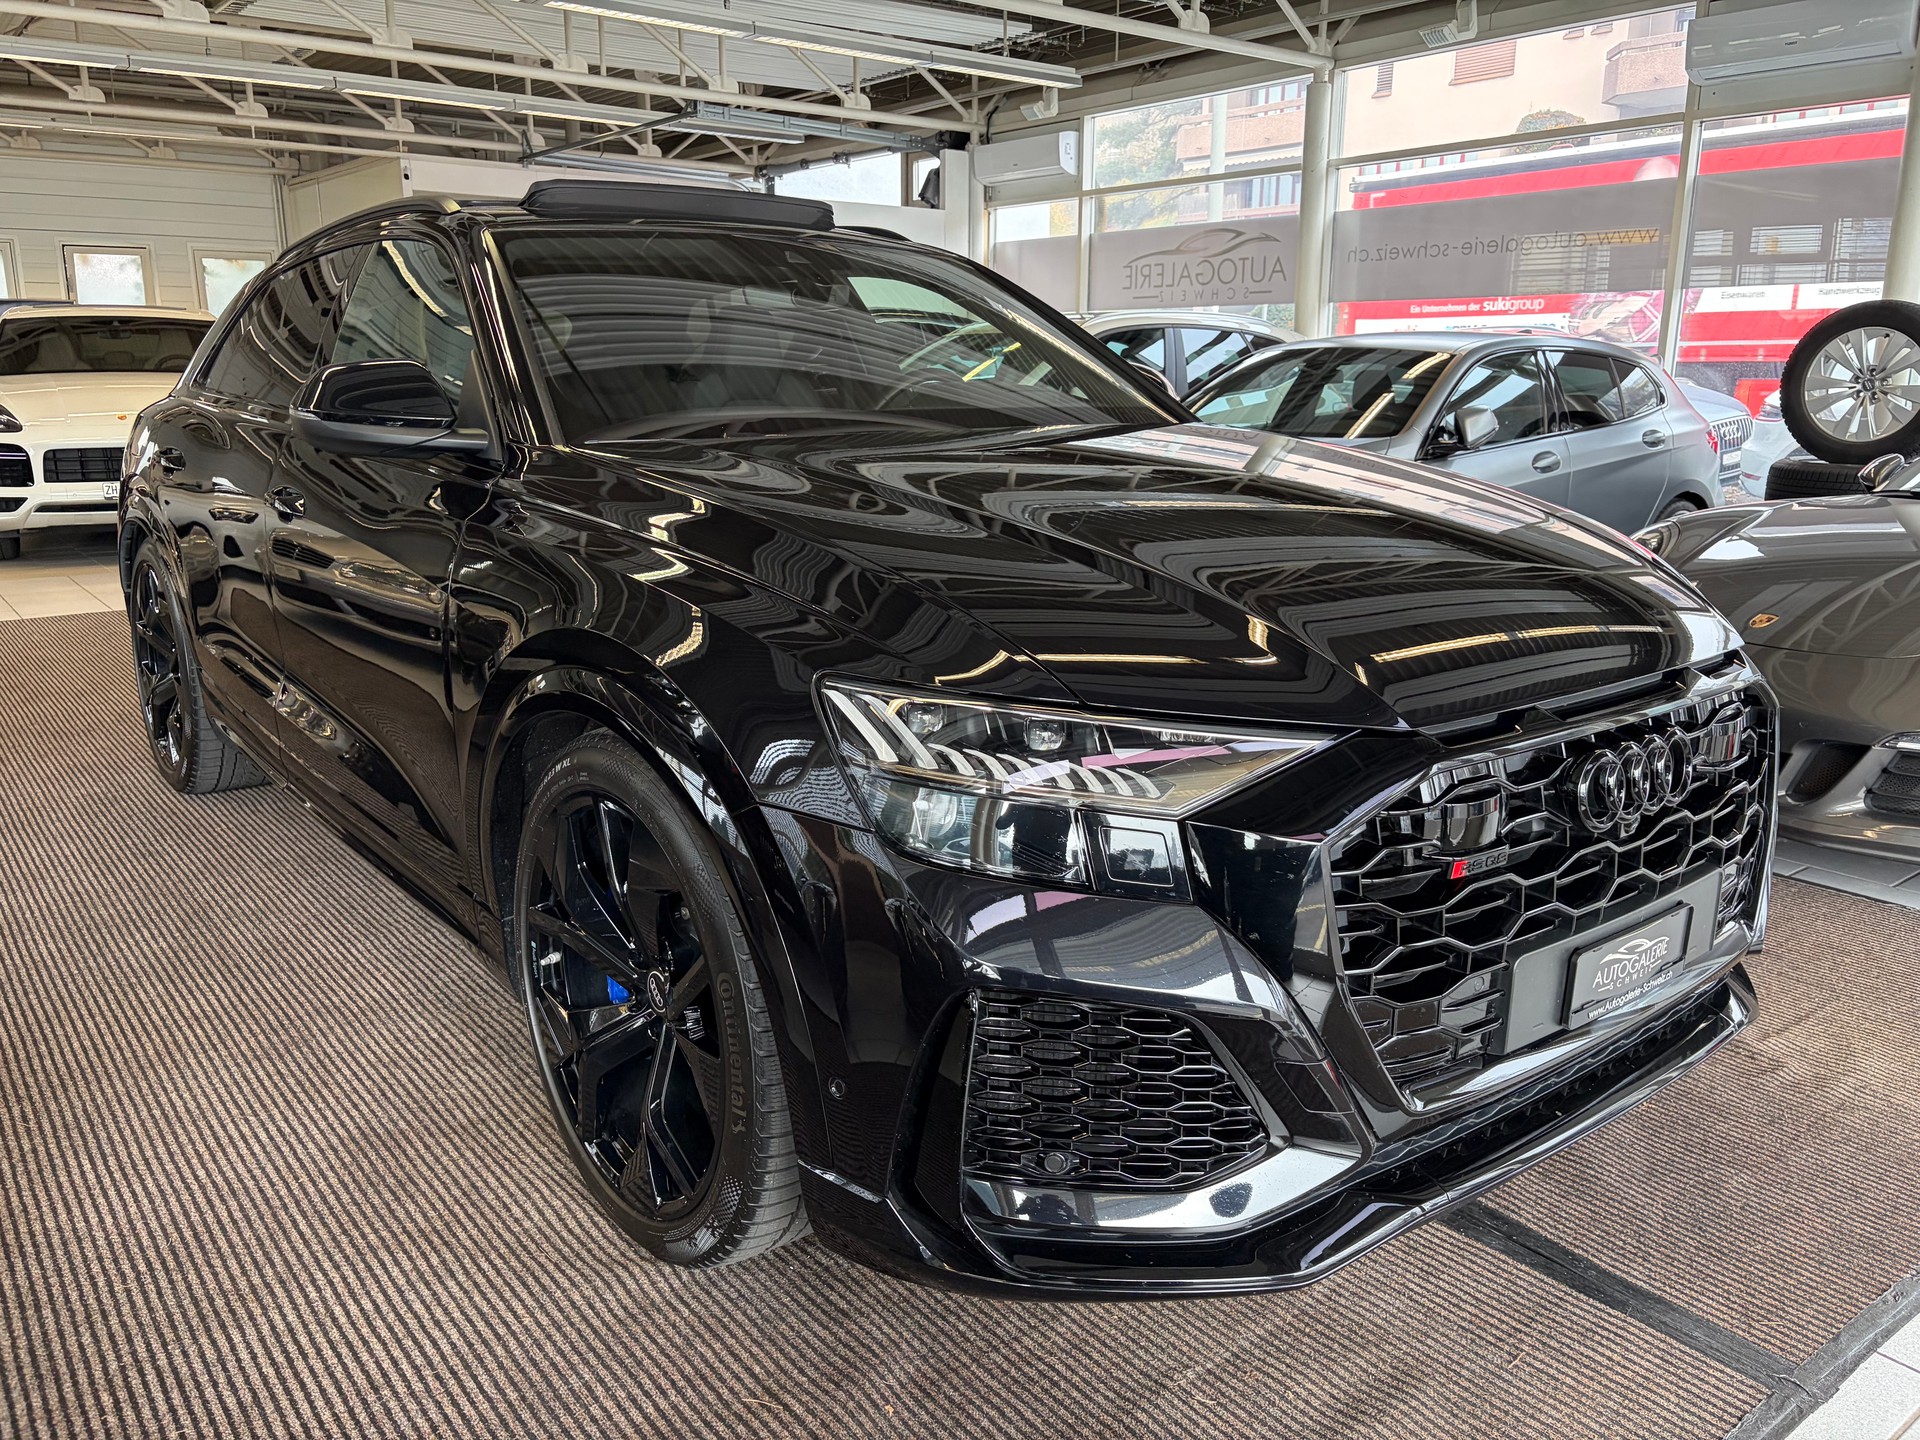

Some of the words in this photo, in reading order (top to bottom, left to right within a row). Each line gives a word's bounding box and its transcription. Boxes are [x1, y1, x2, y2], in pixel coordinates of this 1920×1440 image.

[1410, 305, 1420, 313] Ein
[1422, 303, 1467, 313] Unternehmen
[1468, 303, 1480, 311] der
[1483, 297, 1544, 313] sukigroup
[105, 485, 118, 495] ZH
[1592, 940, 1668, 988] AUTOGALERIE
[1609, 965, 1652, 990] SCHWEIZ
[1588, 971, 1673, 1019] www.Autogalerie-Schweiz.ch
[717, 972, 747, 1117] Continental
